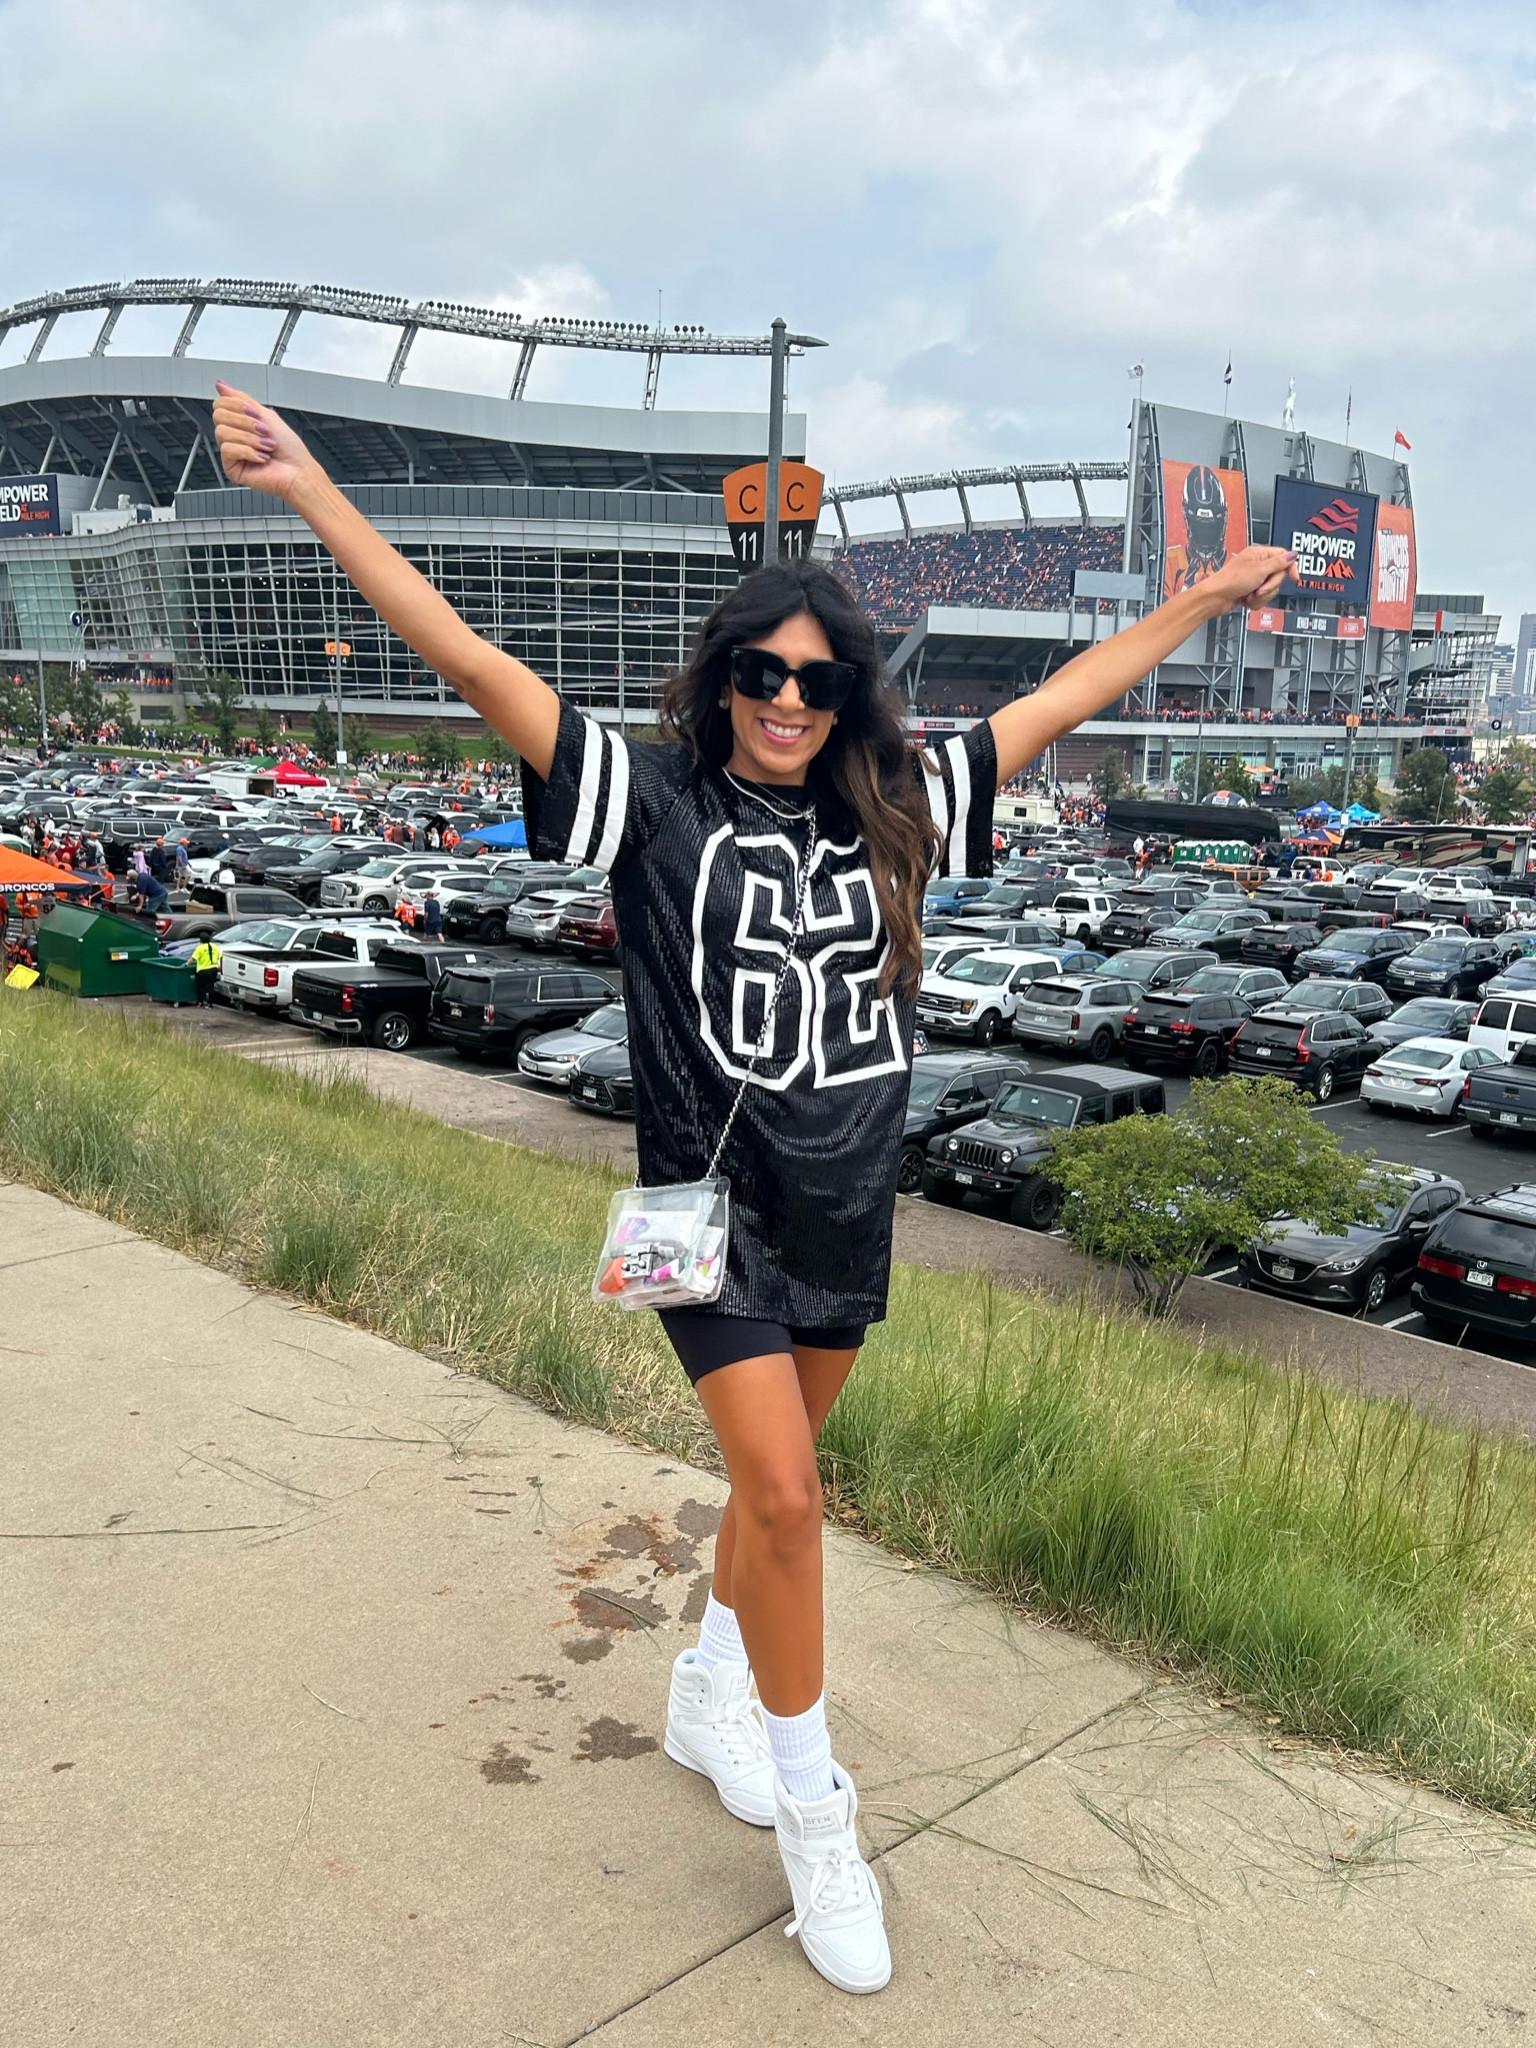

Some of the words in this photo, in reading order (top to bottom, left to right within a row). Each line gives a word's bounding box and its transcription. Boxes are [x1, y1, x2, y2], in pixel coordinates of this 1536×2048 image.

[739, 484, 758, 515] C
[786, 481, 805, 512] C
[738, 531, 757, 562] 11
[784, 529, 802, 560] 11
[1291, 531, 1356, 560] EMPOWER
[1309, 580, 1326, 590] MILE
[1328, 582, 1345, 592] HIGH
